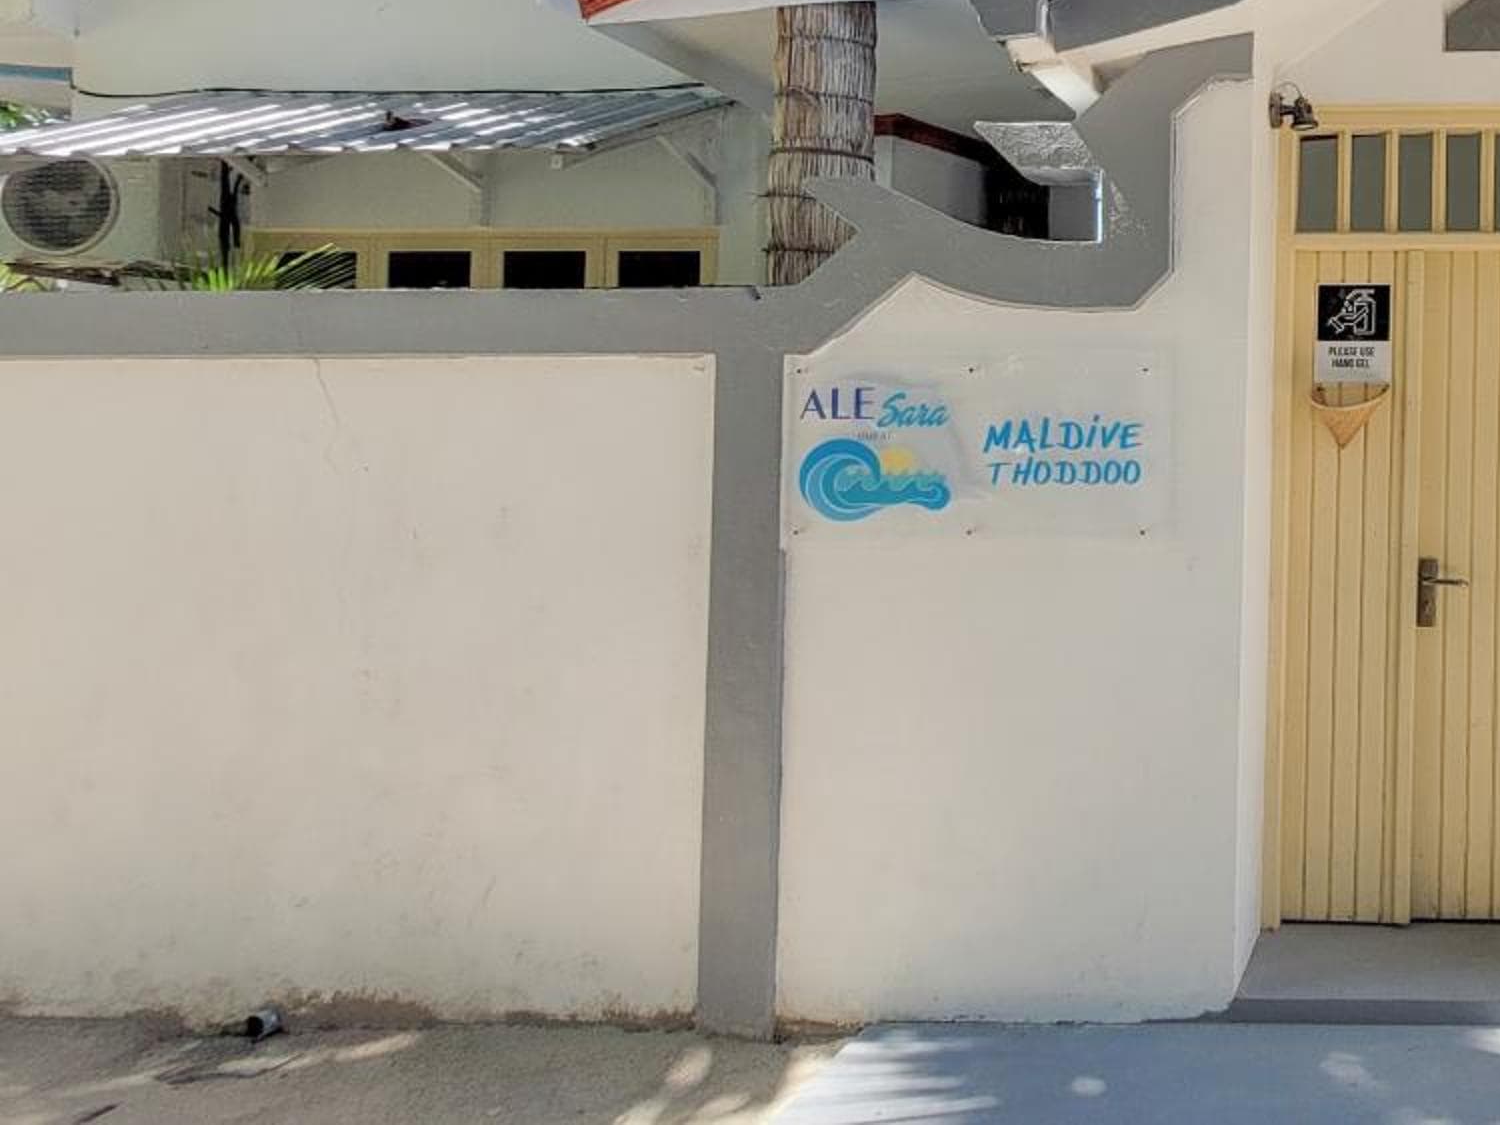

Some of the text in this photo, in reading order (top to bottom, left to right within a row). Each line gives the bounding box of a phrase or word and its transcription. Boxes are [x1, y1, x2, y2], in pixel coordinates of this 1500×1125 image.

[1328, 347, 1375, 356] PLEASE USE
[800, 387, 949, 427] ALE Sara
[987, 458, 1141, 486] THODDOO
